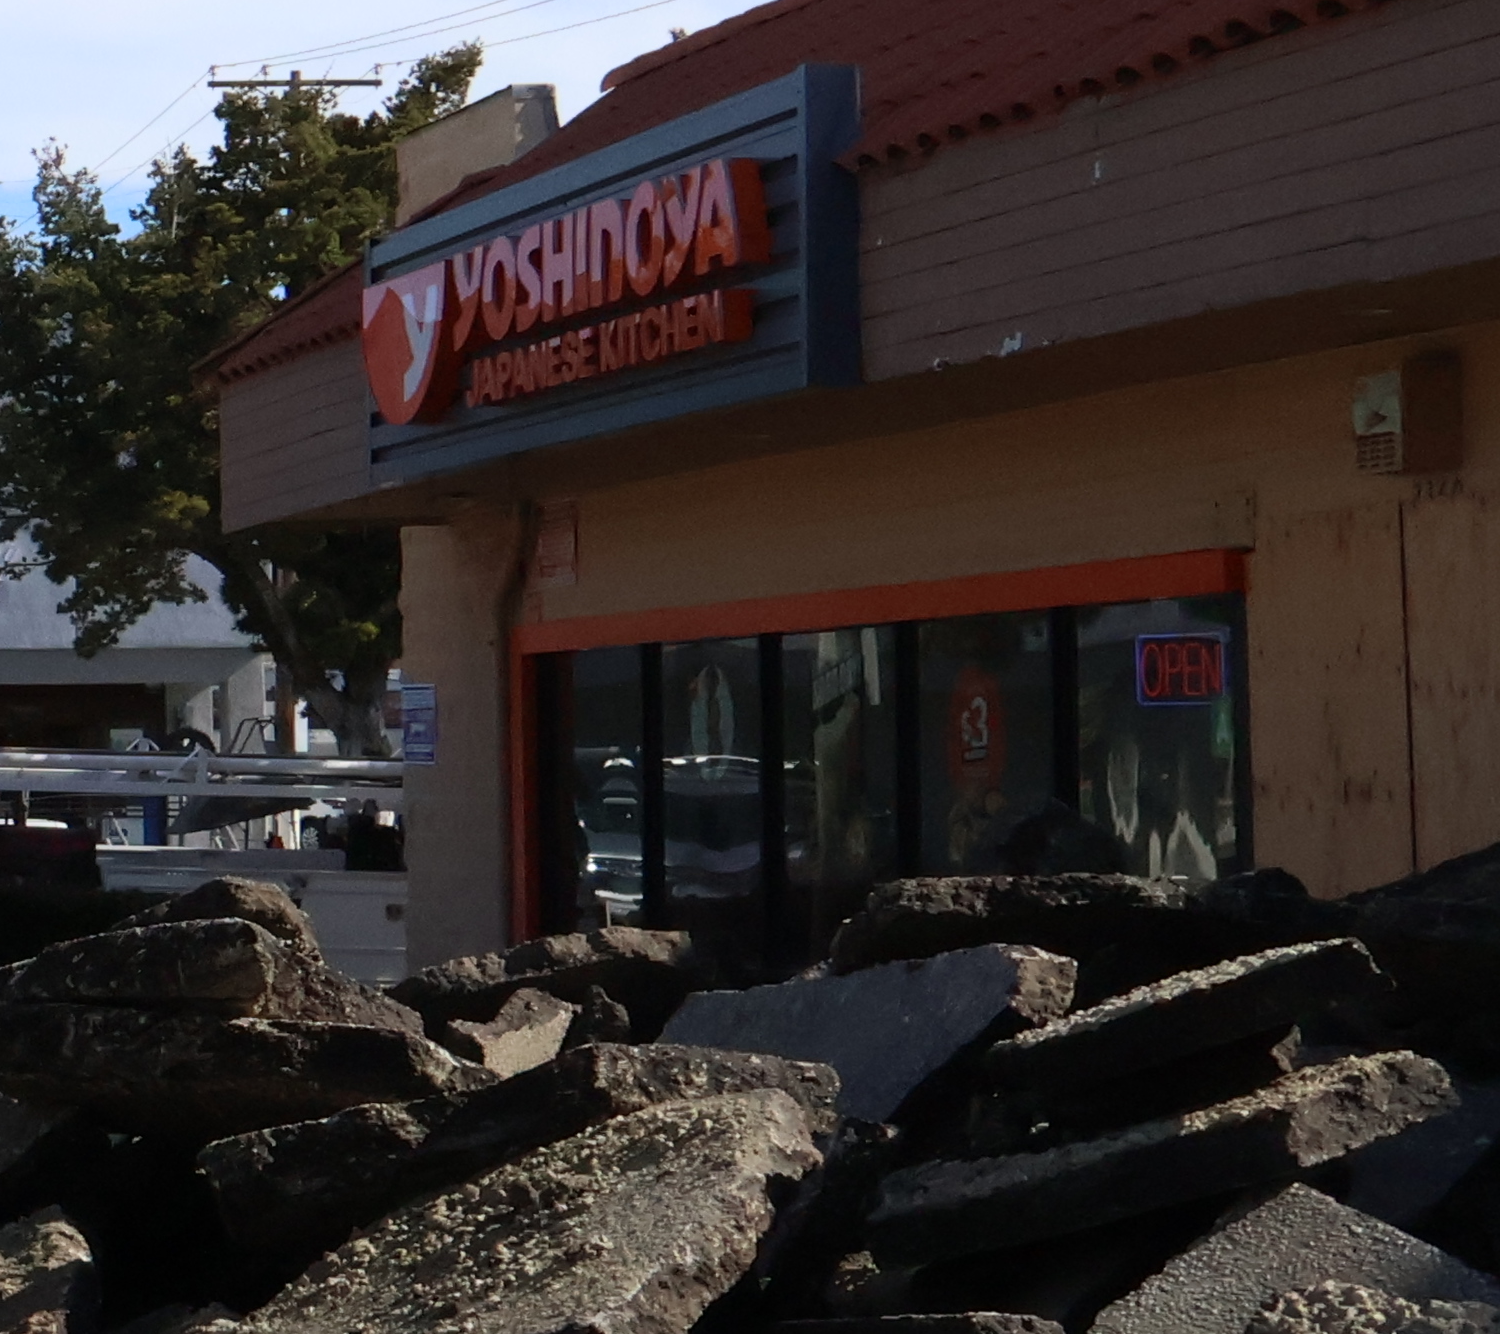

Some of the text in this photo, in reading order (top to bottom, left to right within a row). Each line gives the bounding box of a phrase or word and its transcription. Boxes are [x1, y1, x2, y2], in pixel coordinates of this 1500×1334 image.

[451, 158, 741, 352] YOSHINOYA
[465, 288, 725, 408] JAPANESE KITCHEN
[1141, 642, 1223, 697] OPEN
